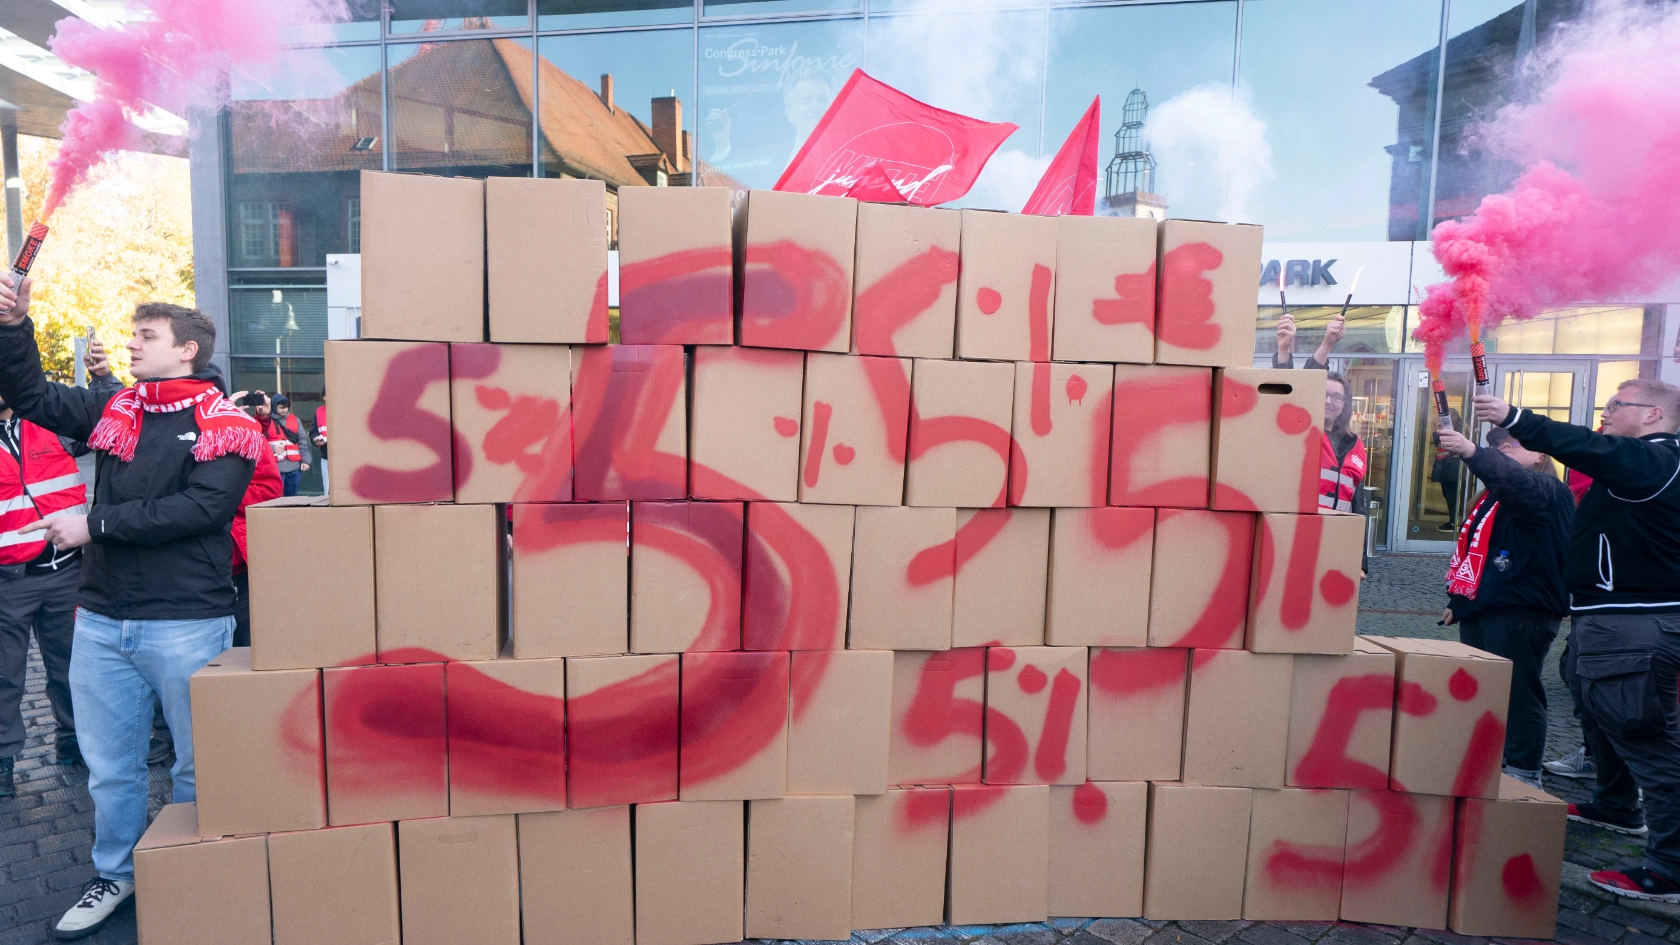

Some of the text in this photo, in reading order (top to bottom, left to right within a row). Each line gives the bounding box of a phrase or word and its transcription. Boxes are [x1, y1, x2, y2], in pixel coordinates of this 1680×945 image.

[718, 37, 856, 90] Sinfonie
[704, 166, 721, 174] Jetzt
[733, 157, 772, 170] Vorverkauf
[19, 238, 39, 270] SMOKE
[1260, 257, 1339, 287] ARK
[1475, 356, 1485, 381] SMOKE
